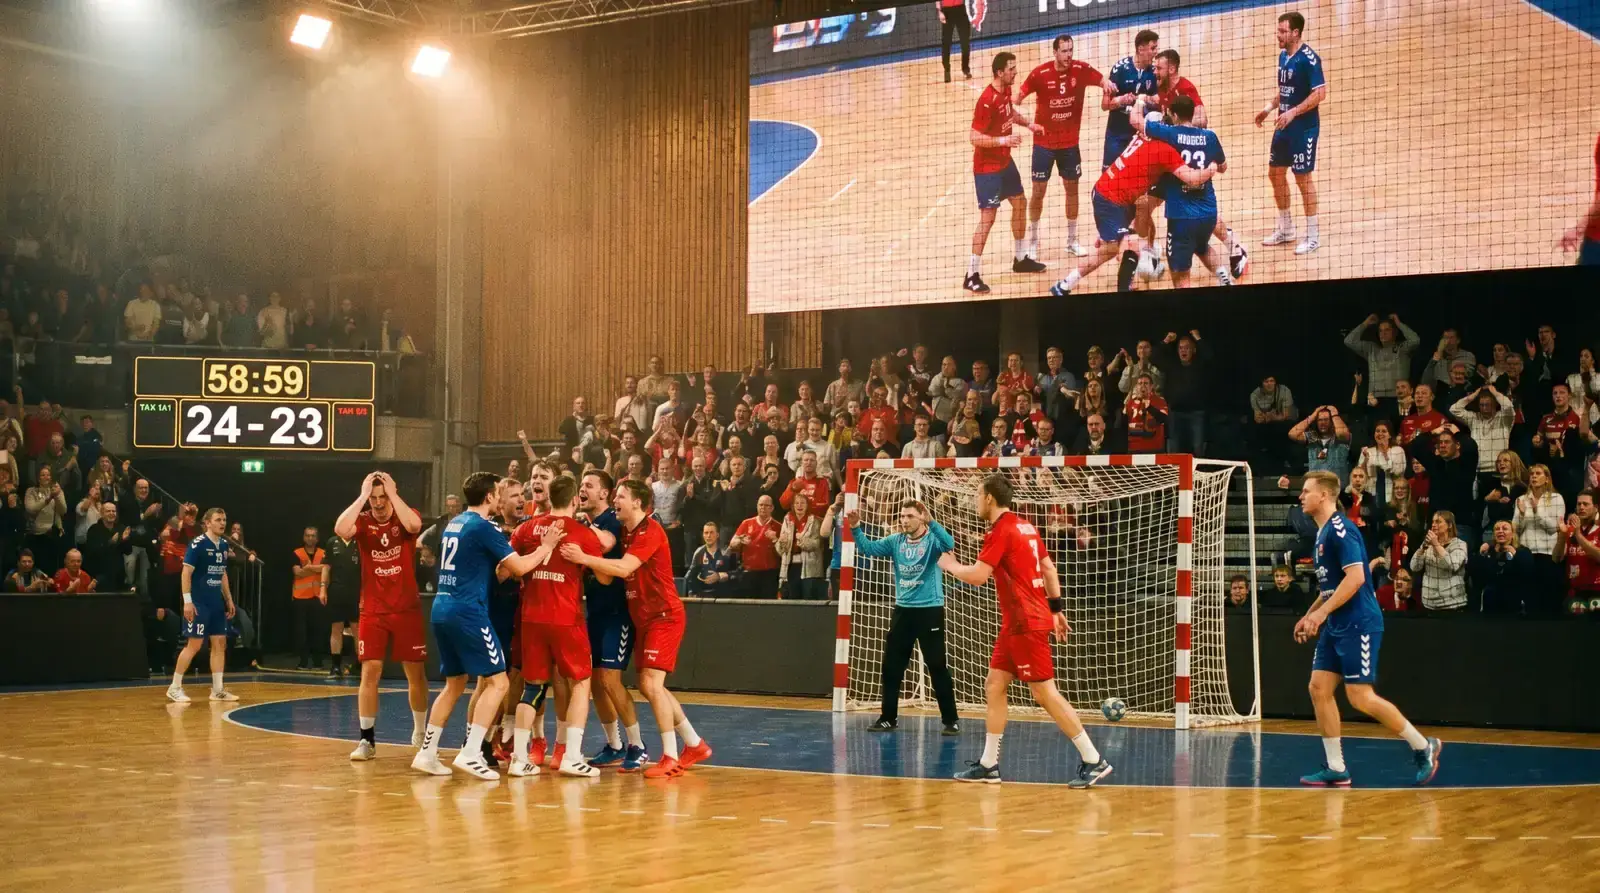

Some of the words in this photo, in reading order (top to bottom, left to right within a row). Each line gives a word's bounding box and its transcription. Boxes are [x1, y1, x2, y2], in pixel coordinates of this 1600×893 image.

[1060, 83, 1066, 95] 5
[207, 363, 304, 395] 58:59
[139, 403, 156, 411] TAX
[440, 536, 459, 571] 12
[196, 623, 205, 635] 12
